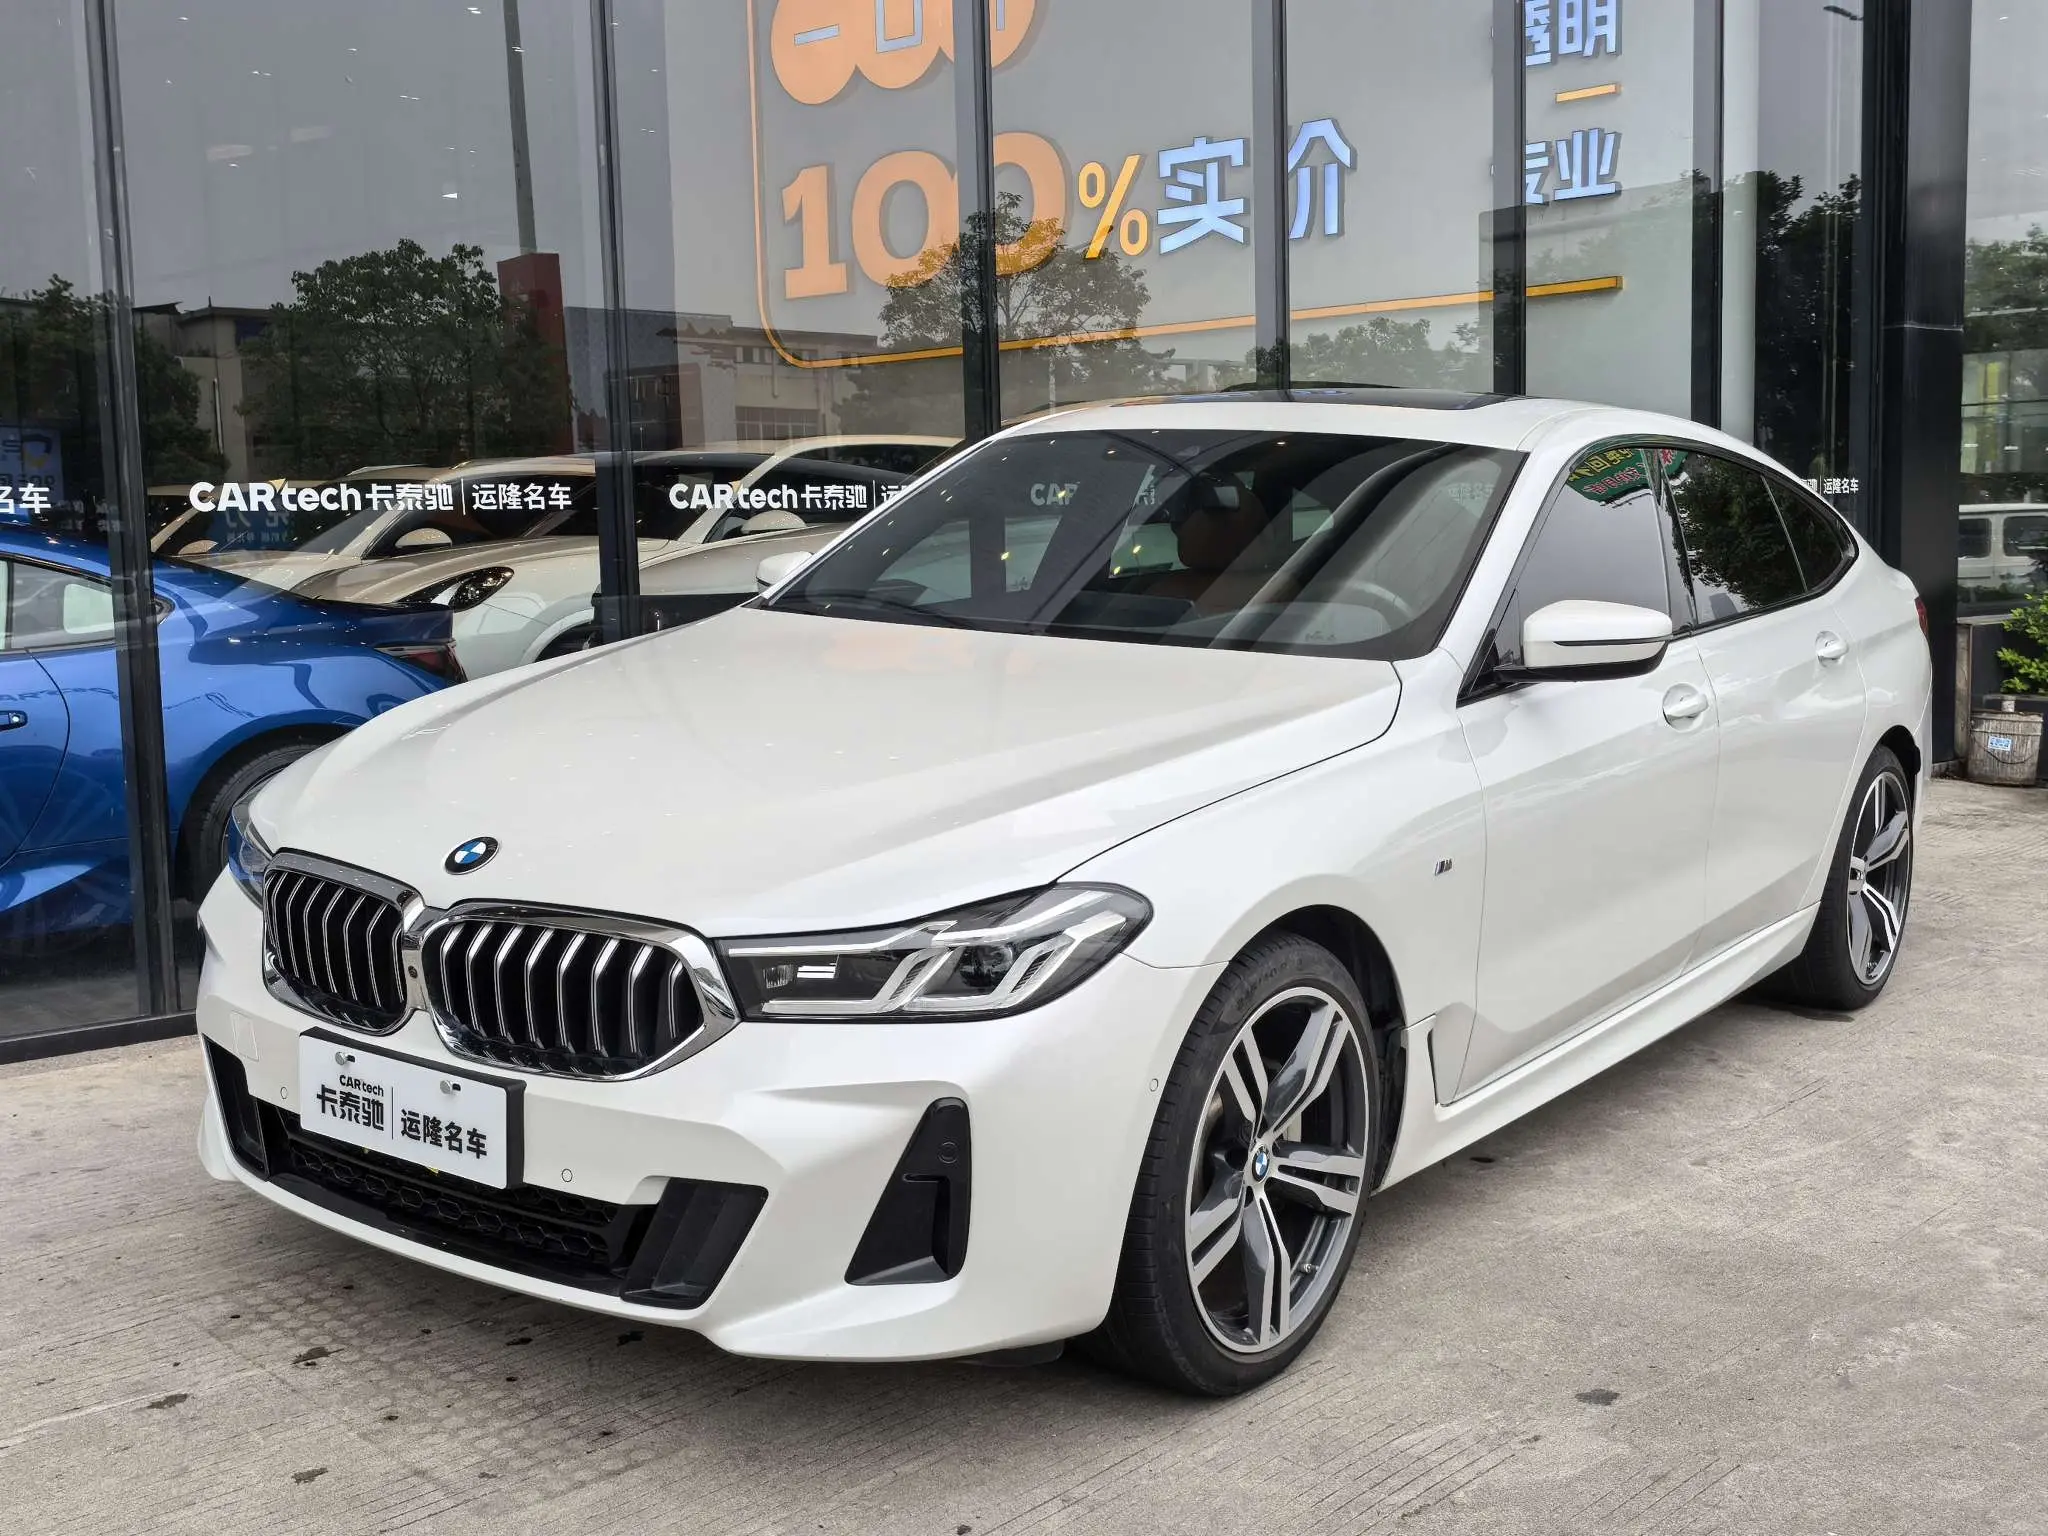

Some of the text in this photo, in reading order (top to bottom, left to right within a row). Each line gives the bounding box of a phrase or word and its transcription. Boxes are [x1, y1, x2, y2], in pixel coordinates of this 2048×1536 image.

[366, 483, 454, 511] 卡泰驰
[472, 483, 572, 510] 运隆名车
[800, 484, 867, 511] 卡泰驰
[1823, 477, 1859, 494] 运隆名车
[316, 1084, 487, 1159] 卡泰驰 运隆名车
